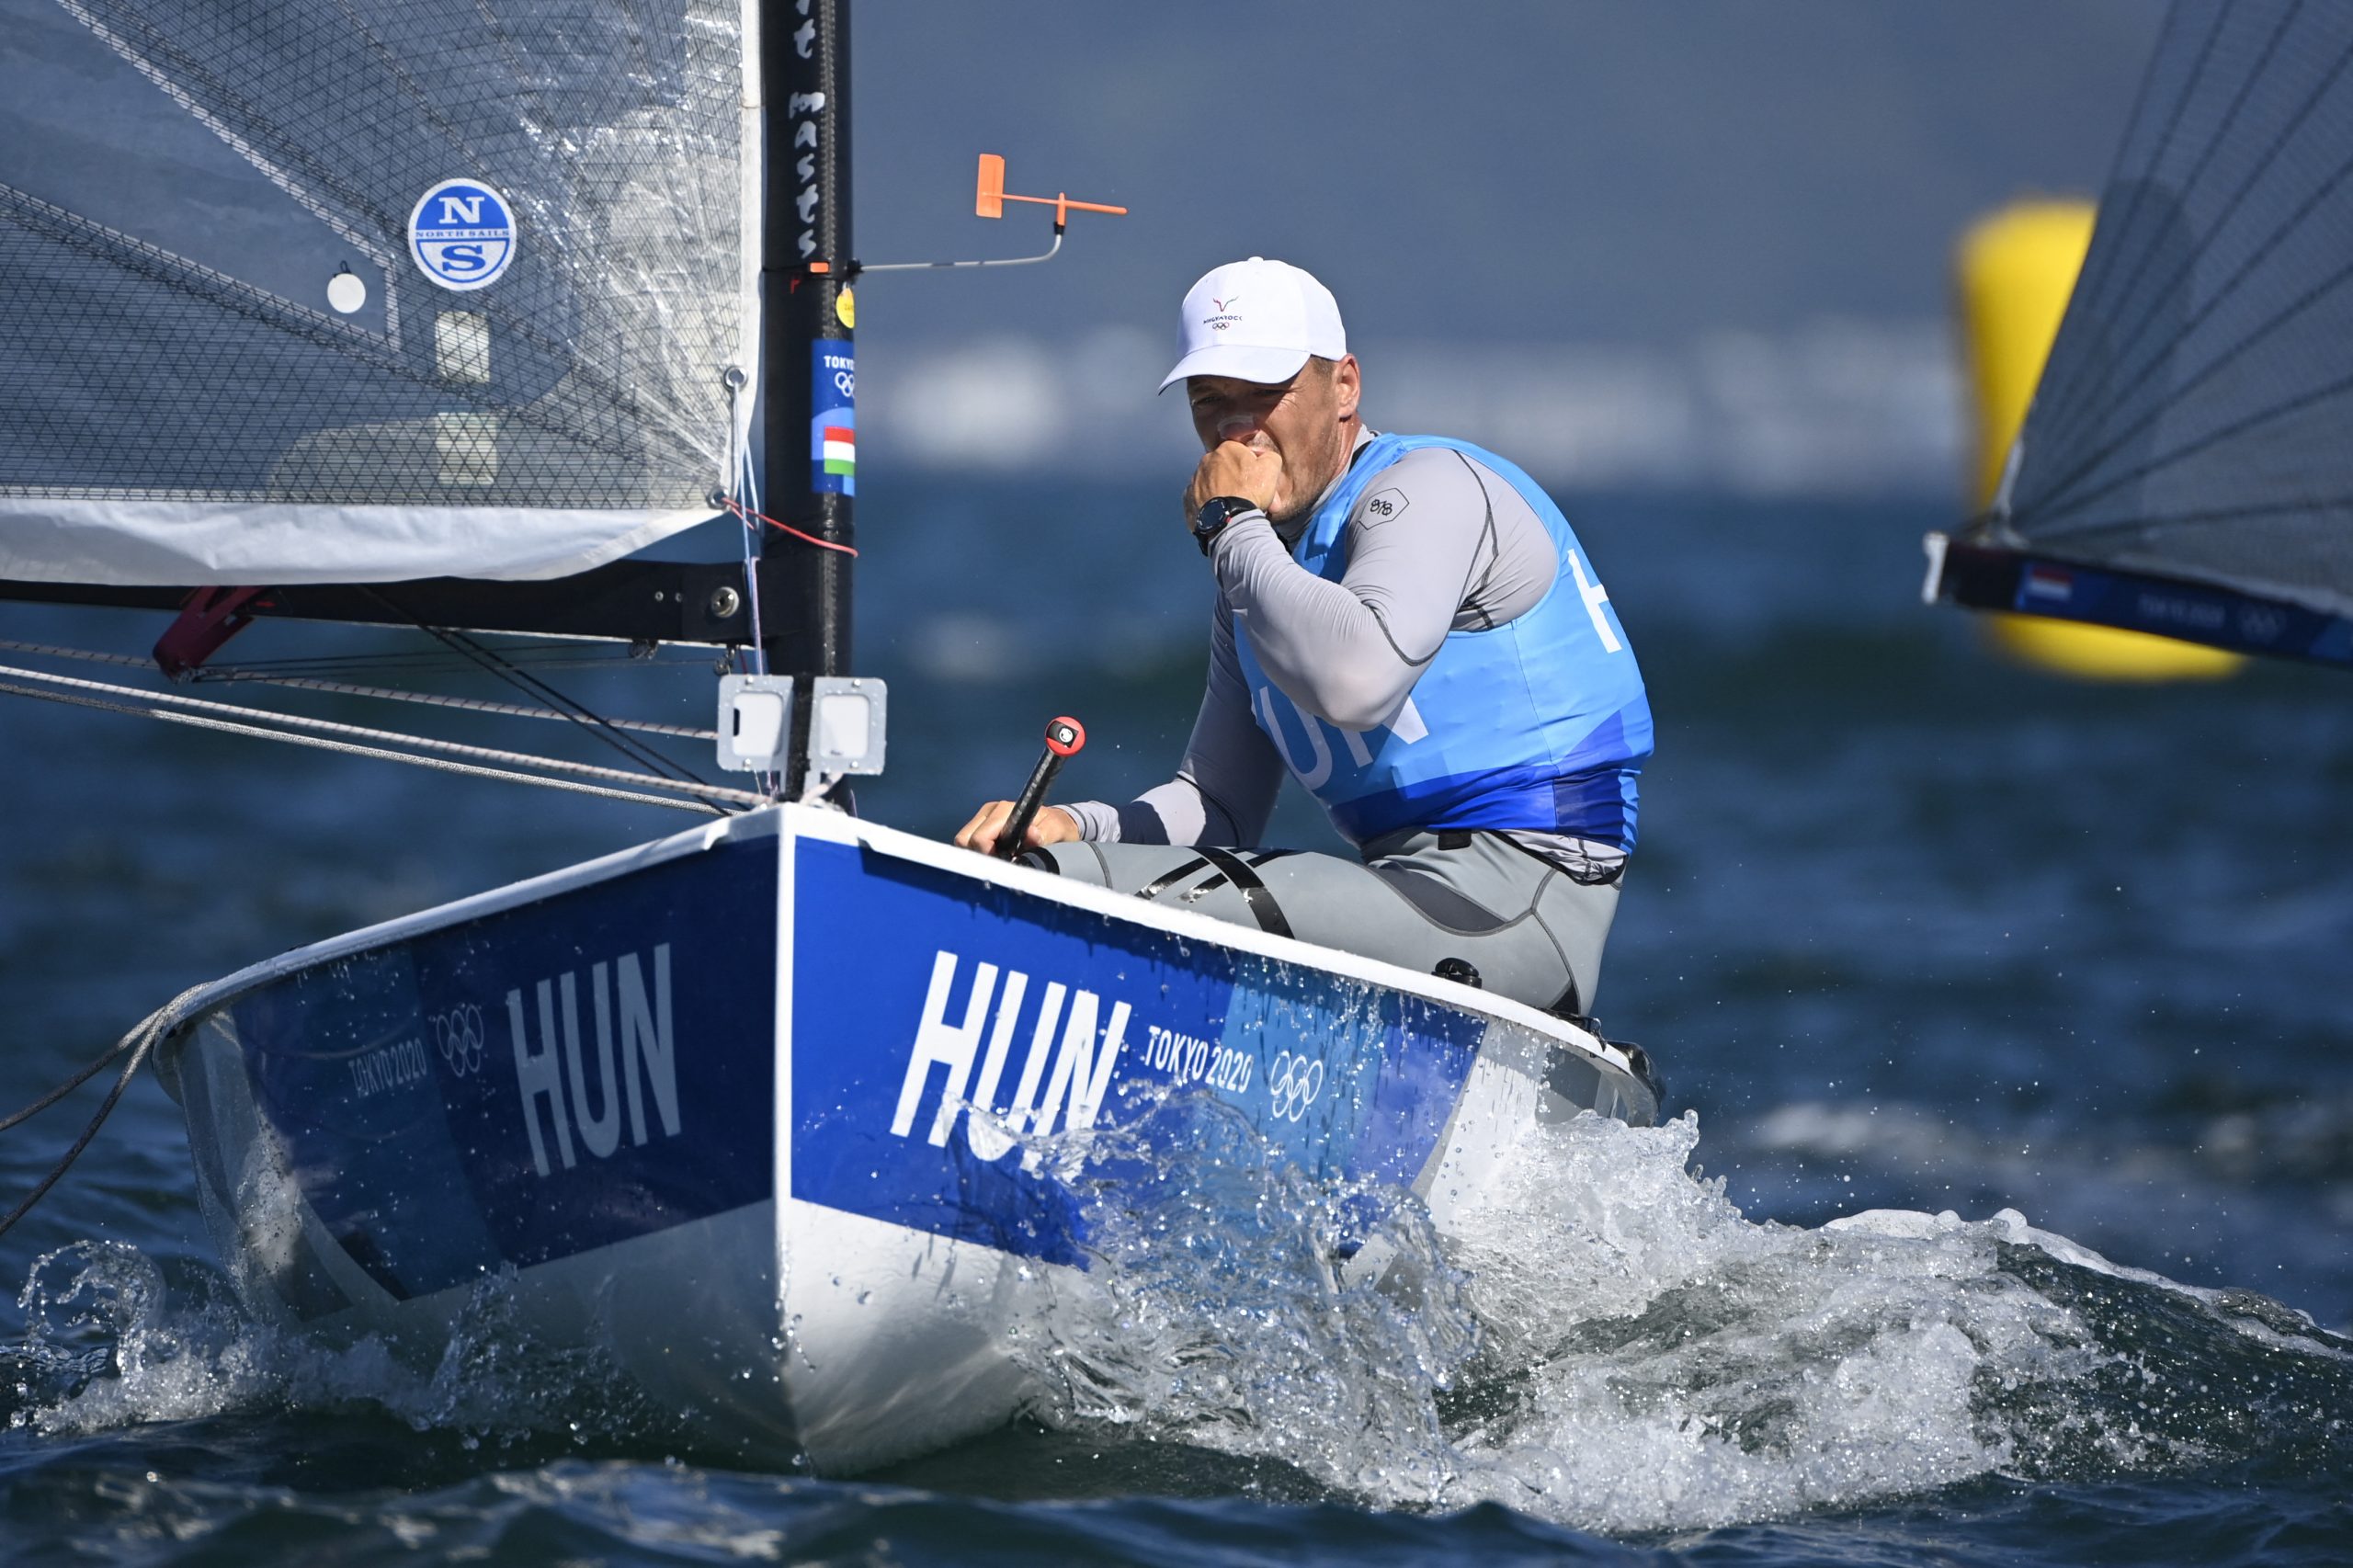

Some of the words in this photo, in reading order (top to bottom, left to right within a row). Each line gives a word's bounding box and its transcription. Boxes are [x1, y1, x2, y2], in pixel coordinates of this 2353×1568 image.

[438, 197, 485, 224] N
[441, 244, 486, 272] S
[347, 1050, 393, 1098] TOKYO
[390, 1037, 427, 1085] 2020
[506, 943, 681, 1177] HUN
[890, 950, 1132, 1180] HUN
[1145, 1025, 1209, 1084] TOKYO
[1205, 1046, 1254, 1094] 2020
